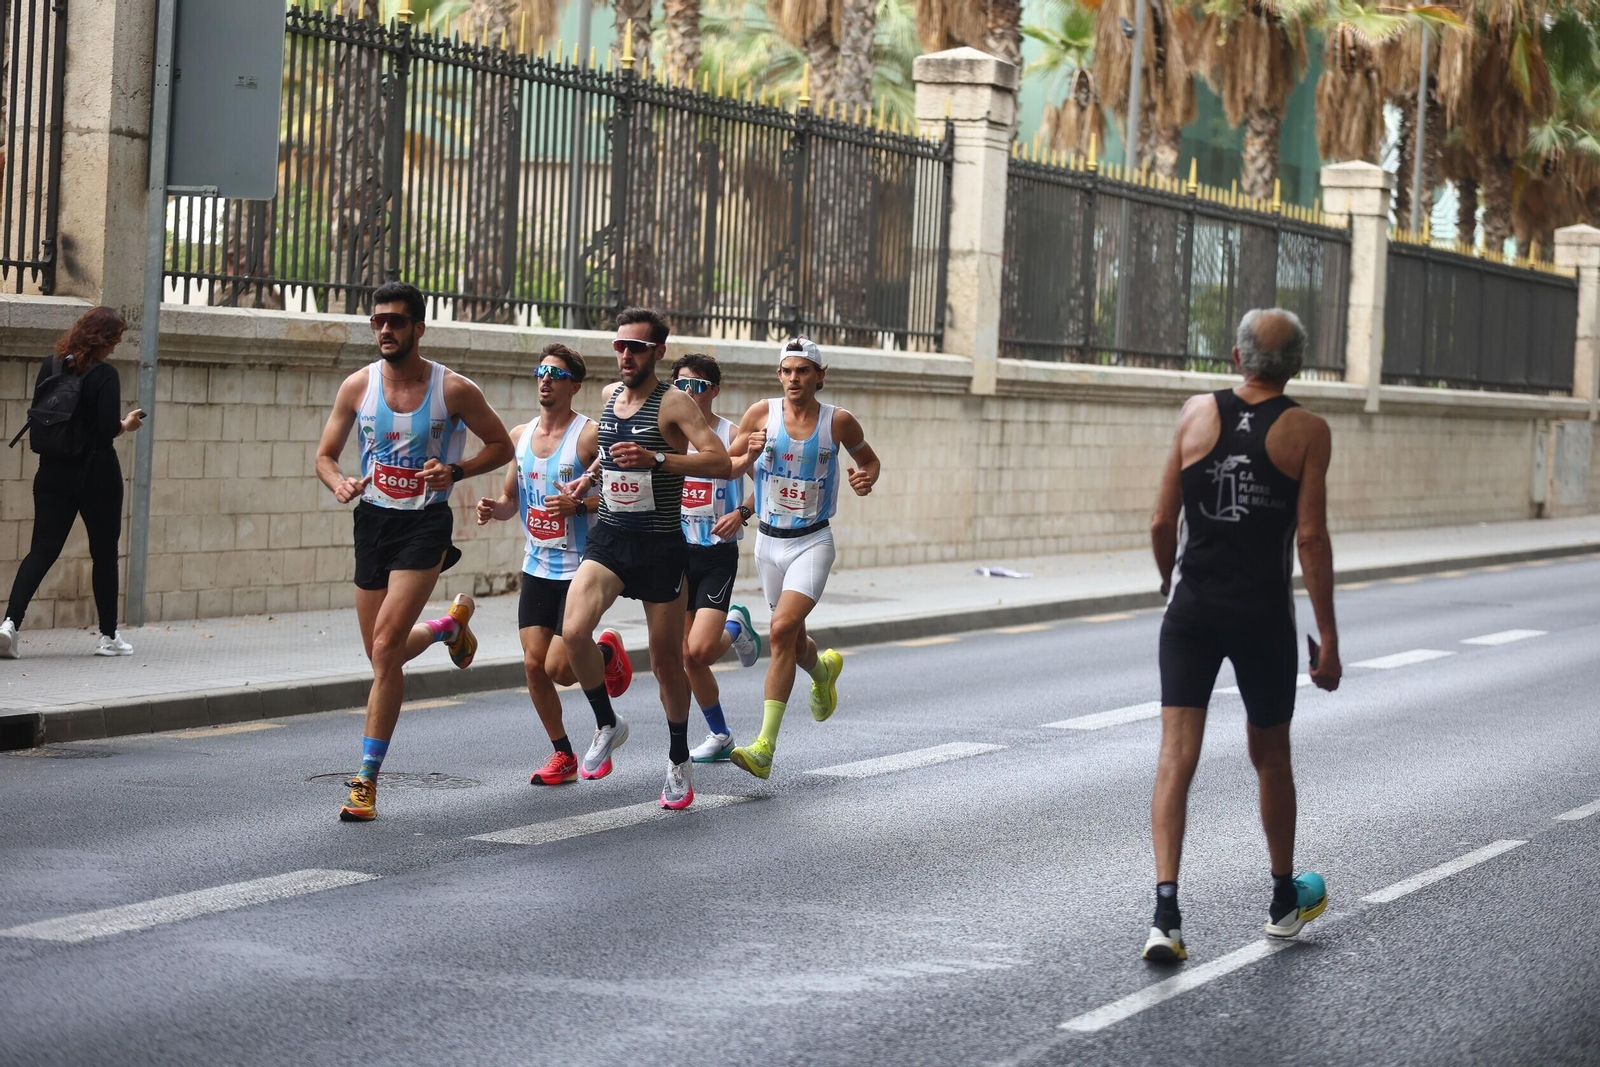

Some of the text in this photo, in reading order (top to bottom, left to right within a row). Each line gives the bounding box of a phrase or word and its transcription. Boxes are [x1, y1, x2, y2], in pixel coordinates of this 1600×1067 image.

[378, 473, 418, 489] 2605
[610, 482, 640, 493] 805
[779, 487, 806, 500] 451
[1238, 494, 1250, 504] DE
[528, 516, 560, 531] 2229
